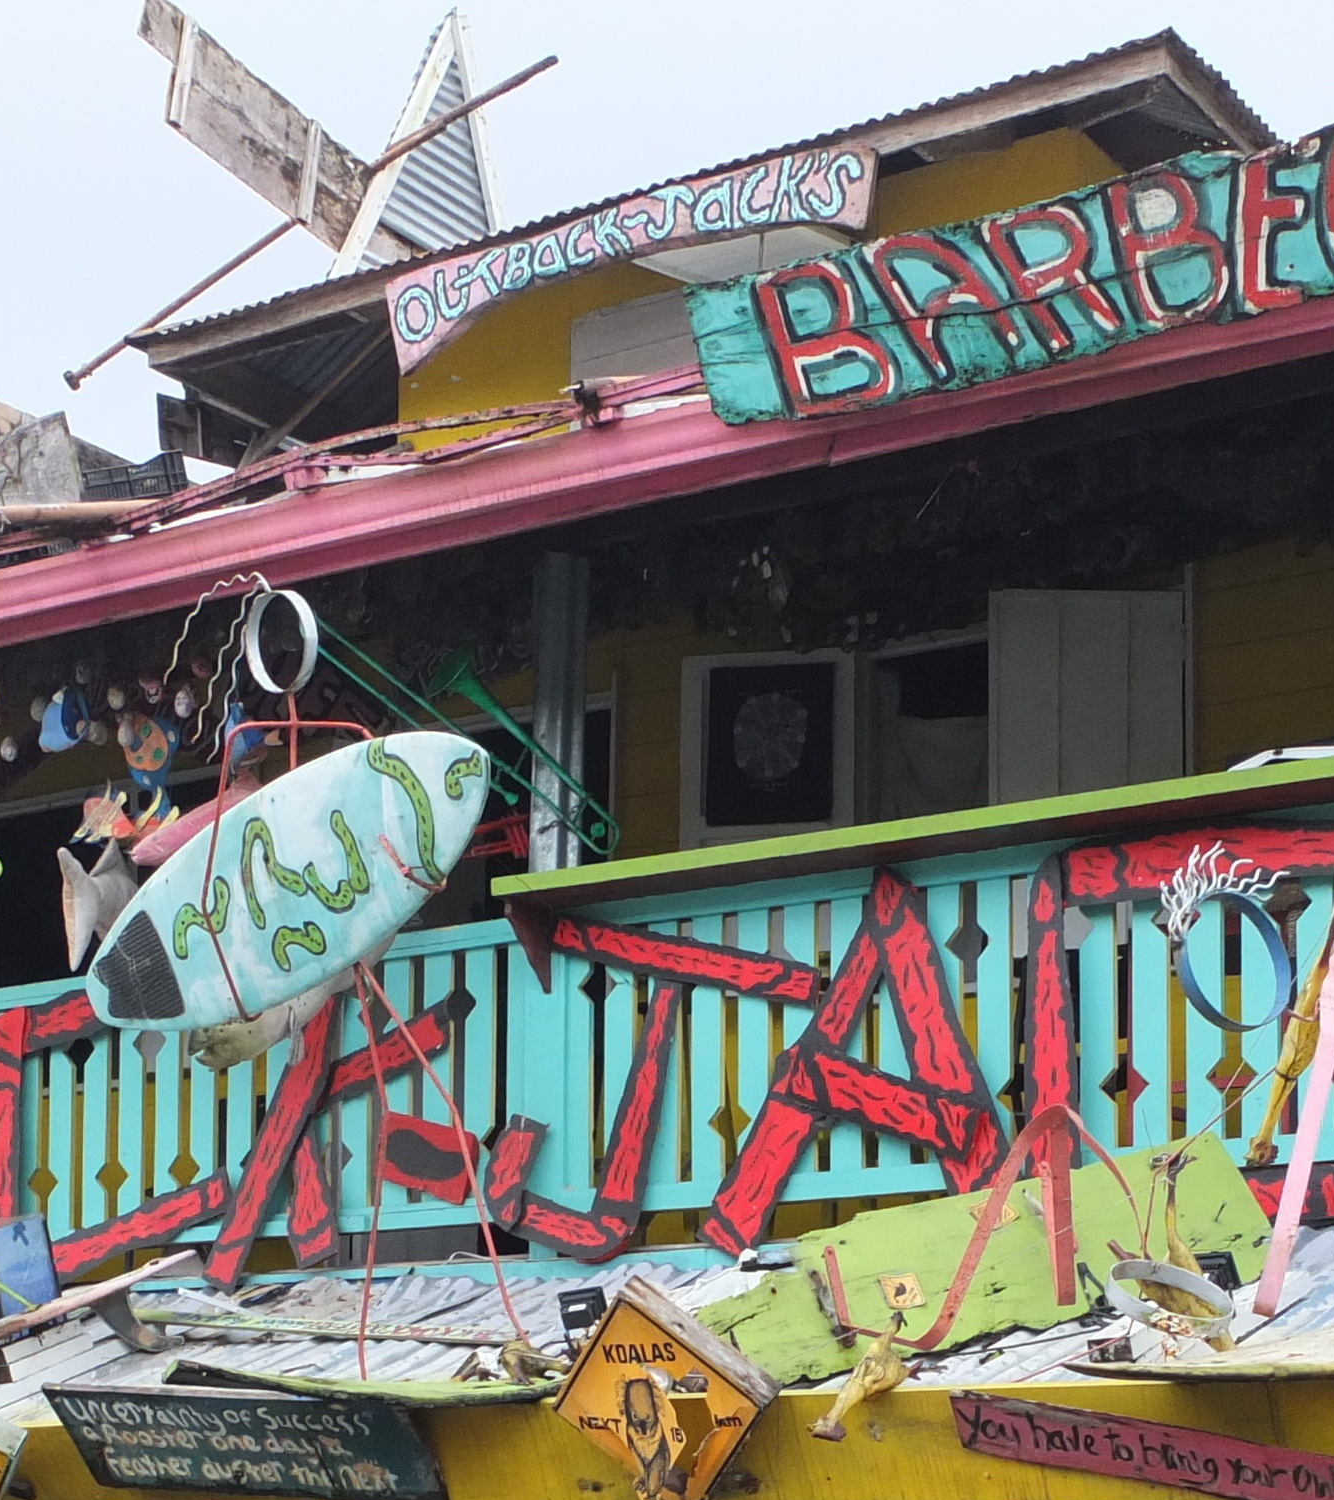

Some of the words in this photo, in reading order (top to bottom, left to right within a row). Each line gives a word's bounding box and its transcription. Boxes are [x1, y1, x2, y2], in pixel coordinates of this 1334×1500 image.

[602, 1341, 677, 1366] KOALAS
[222, 1404, 253, 1428] of
[261, 1405, 372, 1437] Success
[578, 1414, 623, 1435] NEXT
[211, 1432, 262, 1455] one
[1024, 1410, 1099, 1457] have
[1104, 1427, 1134, 1462] to
